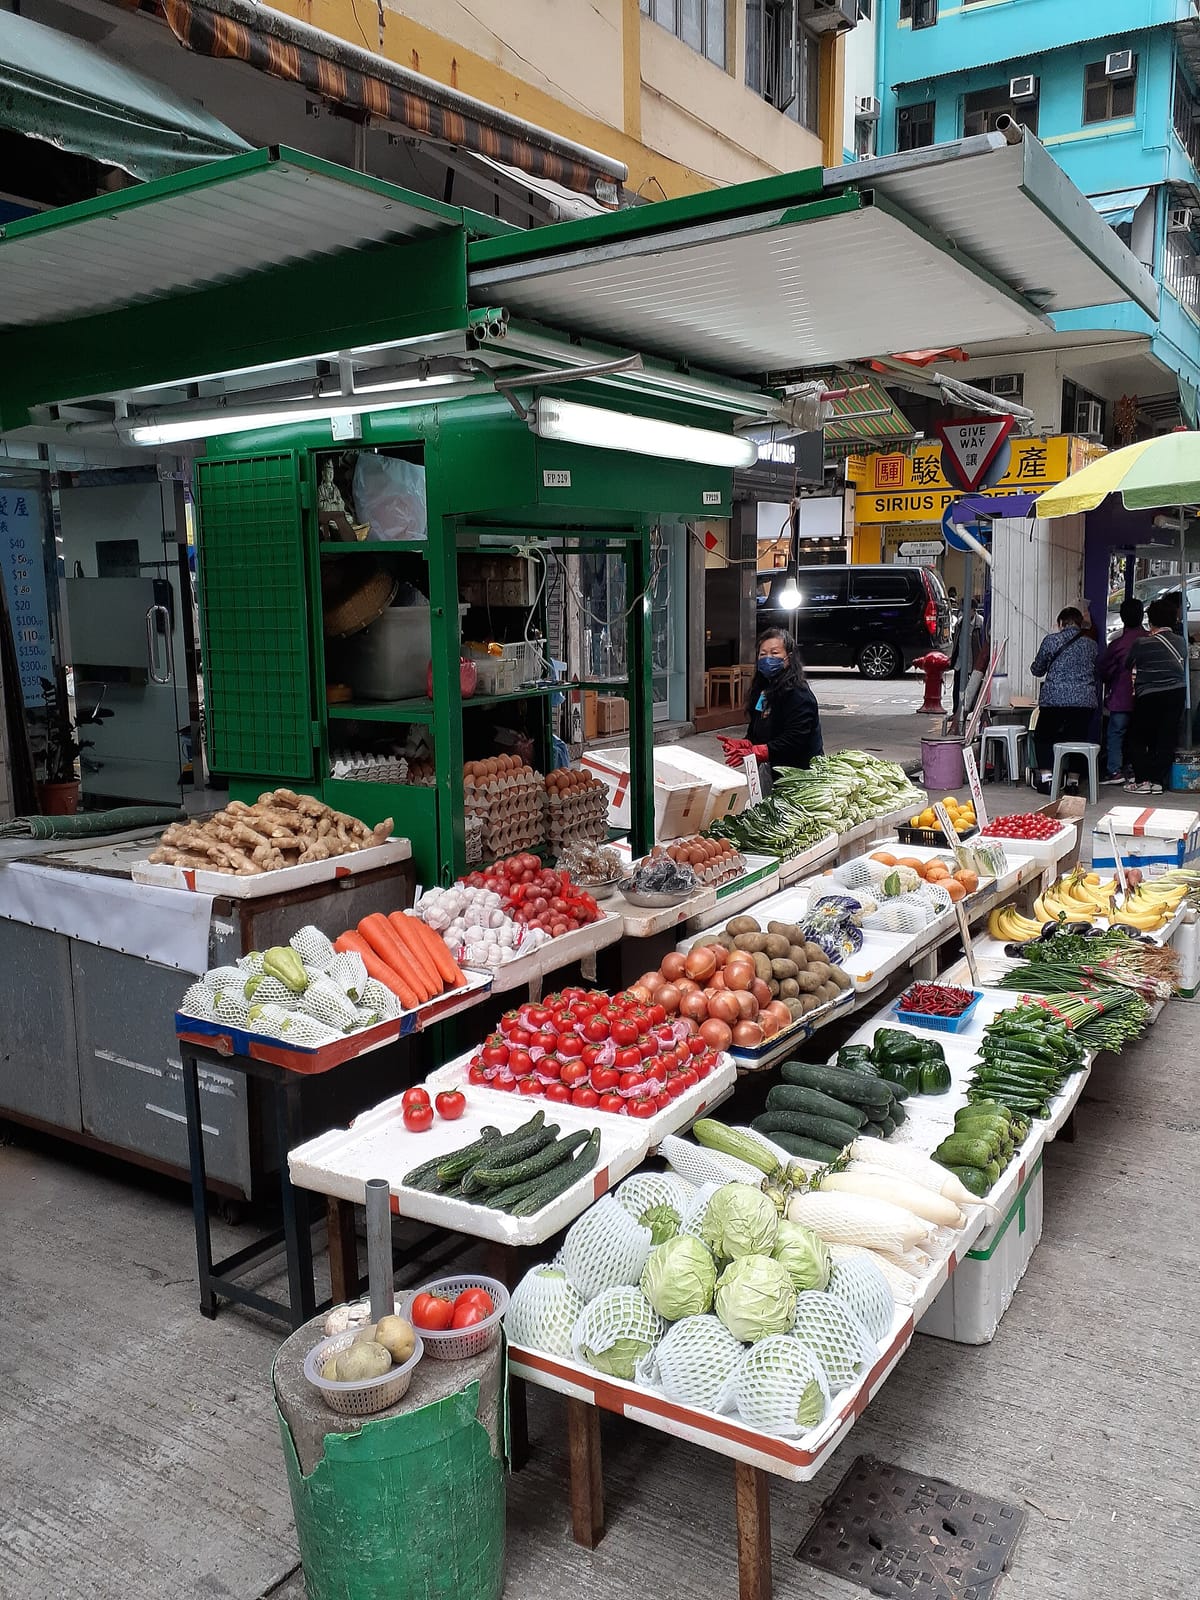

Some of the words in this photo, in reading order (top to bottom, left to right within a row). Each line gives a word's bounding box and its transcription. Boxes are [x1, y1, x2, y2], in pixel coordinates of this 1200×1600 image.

[960, 426, 986, 438] GIVE
[960, 438, 985, 448] WAY
[966, 453, 978, 466] 讓
[875, 496, 933, 512] SIRIUS
[15, 600, 30, 611] $20
